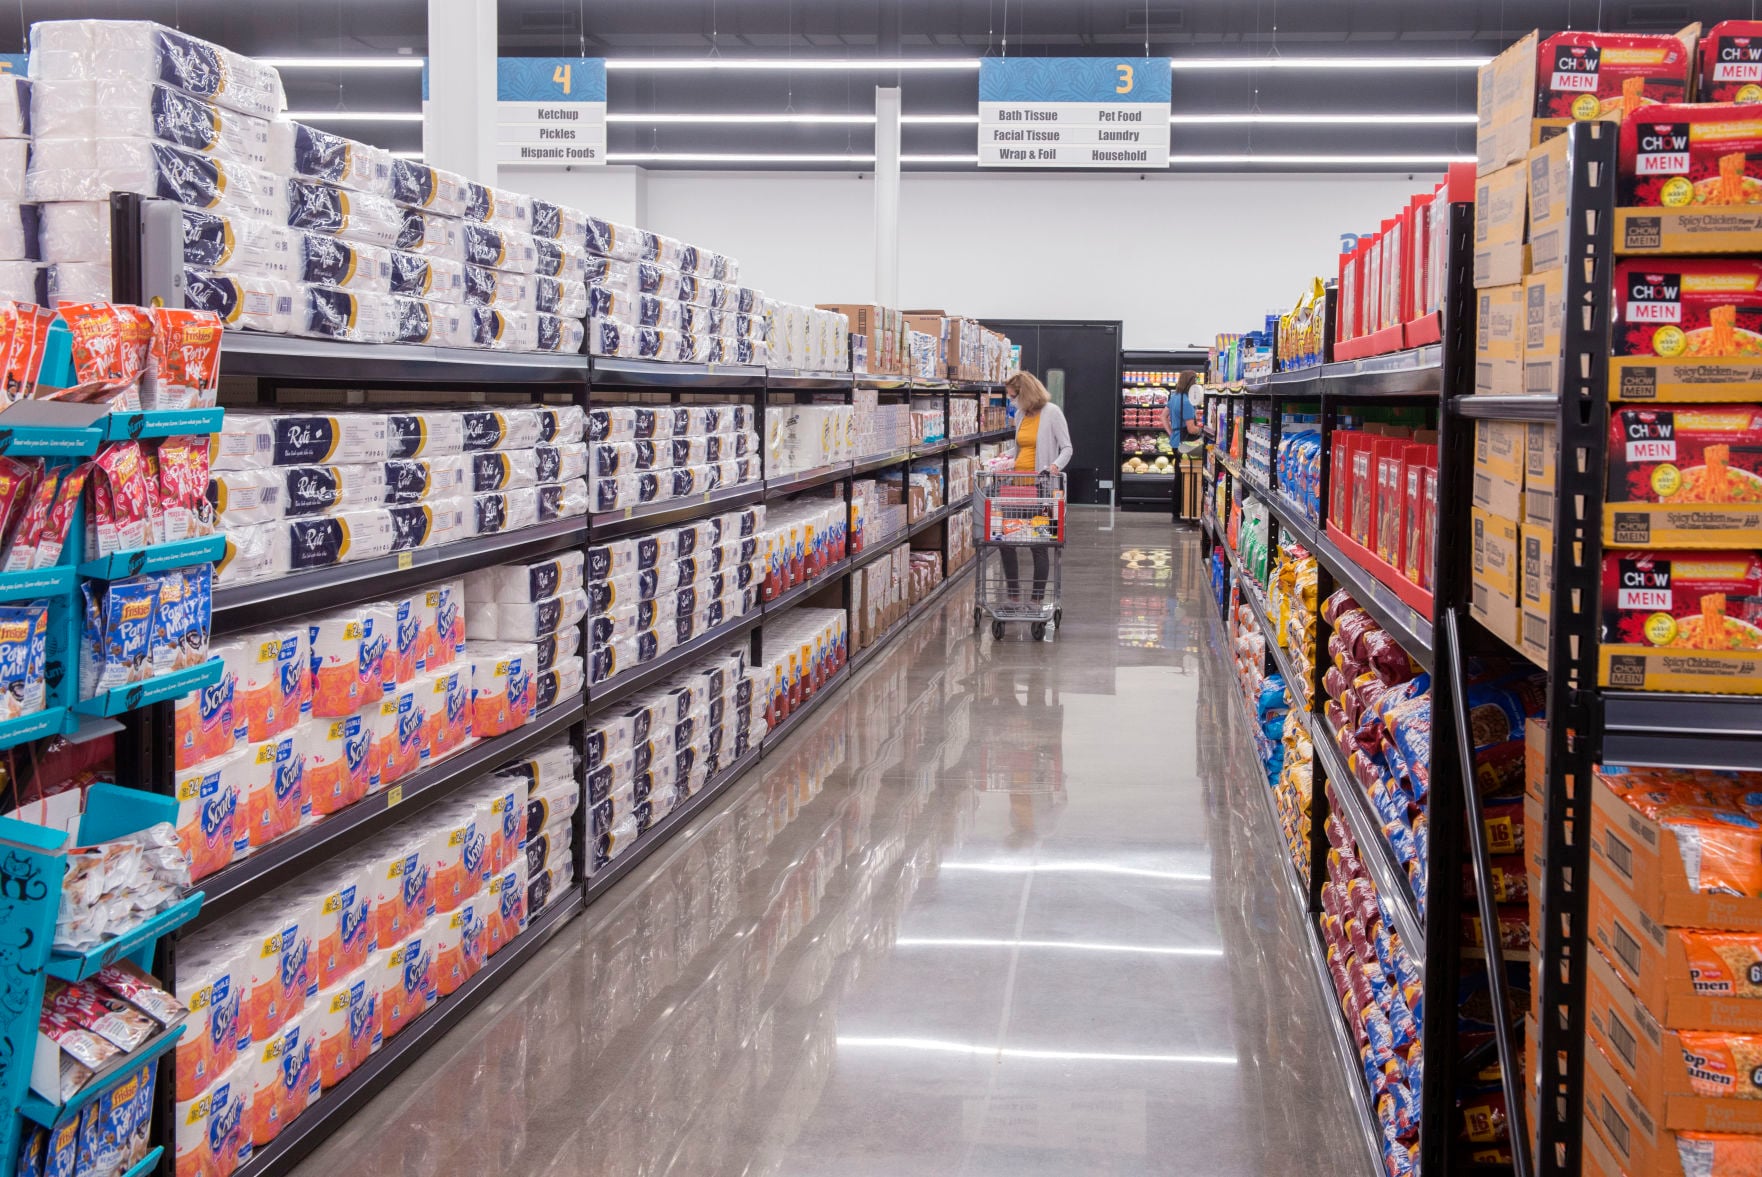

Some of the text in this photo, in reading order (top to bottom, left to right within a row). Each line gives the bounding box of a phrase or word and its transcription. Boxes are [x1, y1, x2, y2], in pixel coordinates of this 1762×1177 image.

[1722, 47, 1762, 60] CHOW
[1558, 57, 1598, 71] CHOW
[1723, 66, 1758, 77] MEIN
[552, 64, 571, 94] 4
[1115, 64, 1134, 94] 3
[1559, 75, 1594, 88] MEIN
[537, 109, 579, 120] Ketchup
[999, 110, 1058, 121] Bath Tissue
[1099, 111, 1142, 121] Pet Food
[540, 128, 576, 139] Pickles
[994, 130, 1060, 141] Facial Tissue
[1098, 130, 1139, 142] Laundry
[1642, 136, 1687, 150] CHOW
[521, 147, 595, 159] Hispanic Foods
[1000, 149, 1057, 160] Wrap & Foil
[1092, 150, 1147, 161] Household
[1645, 156, 1684, 170] MEIN
[1678, 215, 1702, 226] Spicy
[1703, 215, 1738, 224] Chicken
[1629, 237, 1657, 245] MEIN
[1632, 285, 1678, 299] CHOW
[1635, 305, 1676, 318] MEIN
[179, 344, 210, 362] Party
[1673, 366, 1697, 377] Spicy
[1697, 366, 1733, 375] Chicken
[1623, 387, 1652, 395] MEIN
[1628, 424, 1672, 438] CHOW
[1634, 444, 1671, 457] MEIN
[1667, 513, 1690, 524] Spicy
[1691, 512, 1726, 522] Chicken
[1618, 532, 1647, 541] MEIN
[1624, 572, 1668, 586] CHOW
[1627, 592, 1667, 605] MEIN
[440, 601, 456, 635] Scott
[400, 615, 417, 650] Scott
[267, 641, 279, 658] 24
[360, 633, 385, 670] Scott
[1662, 657, 1686, 668] Spicy
[1686, 657, 1722, 667] Chicken
[1613, 674, 1641, 683] MEIN
[400, 706, 420, 742] Scott
[266, 744, 276, 760] 24
[350, 728, 370, 770] Scott
[278, 752, 301, 796] Scott
[188, 777, 200, 796] 24
[207, 785, 232, 834] Scott
[1490, 823, 1509, 842] 16
[467, 832, 485, 869] Scott
[406, 864, 426, 902] Scott
[271, 936, 282, 953] 24
[285, 937, 306, 985] Scott
[408, 950, 429, 990] Scott
[212, 979, 230, 994] DOUBLE
[351, 984, 365, 996] DOUBLE
[199, 988, 211, 1008] 24
[339, 992, 350, 1007] 24
[1687, 1067, 1731, 1085] amen
[212, 1089, 229, 1104] DOUBLE
[199, 1102, 211, 1120] 24
[1470, 1112, 1489, 1132] 16
